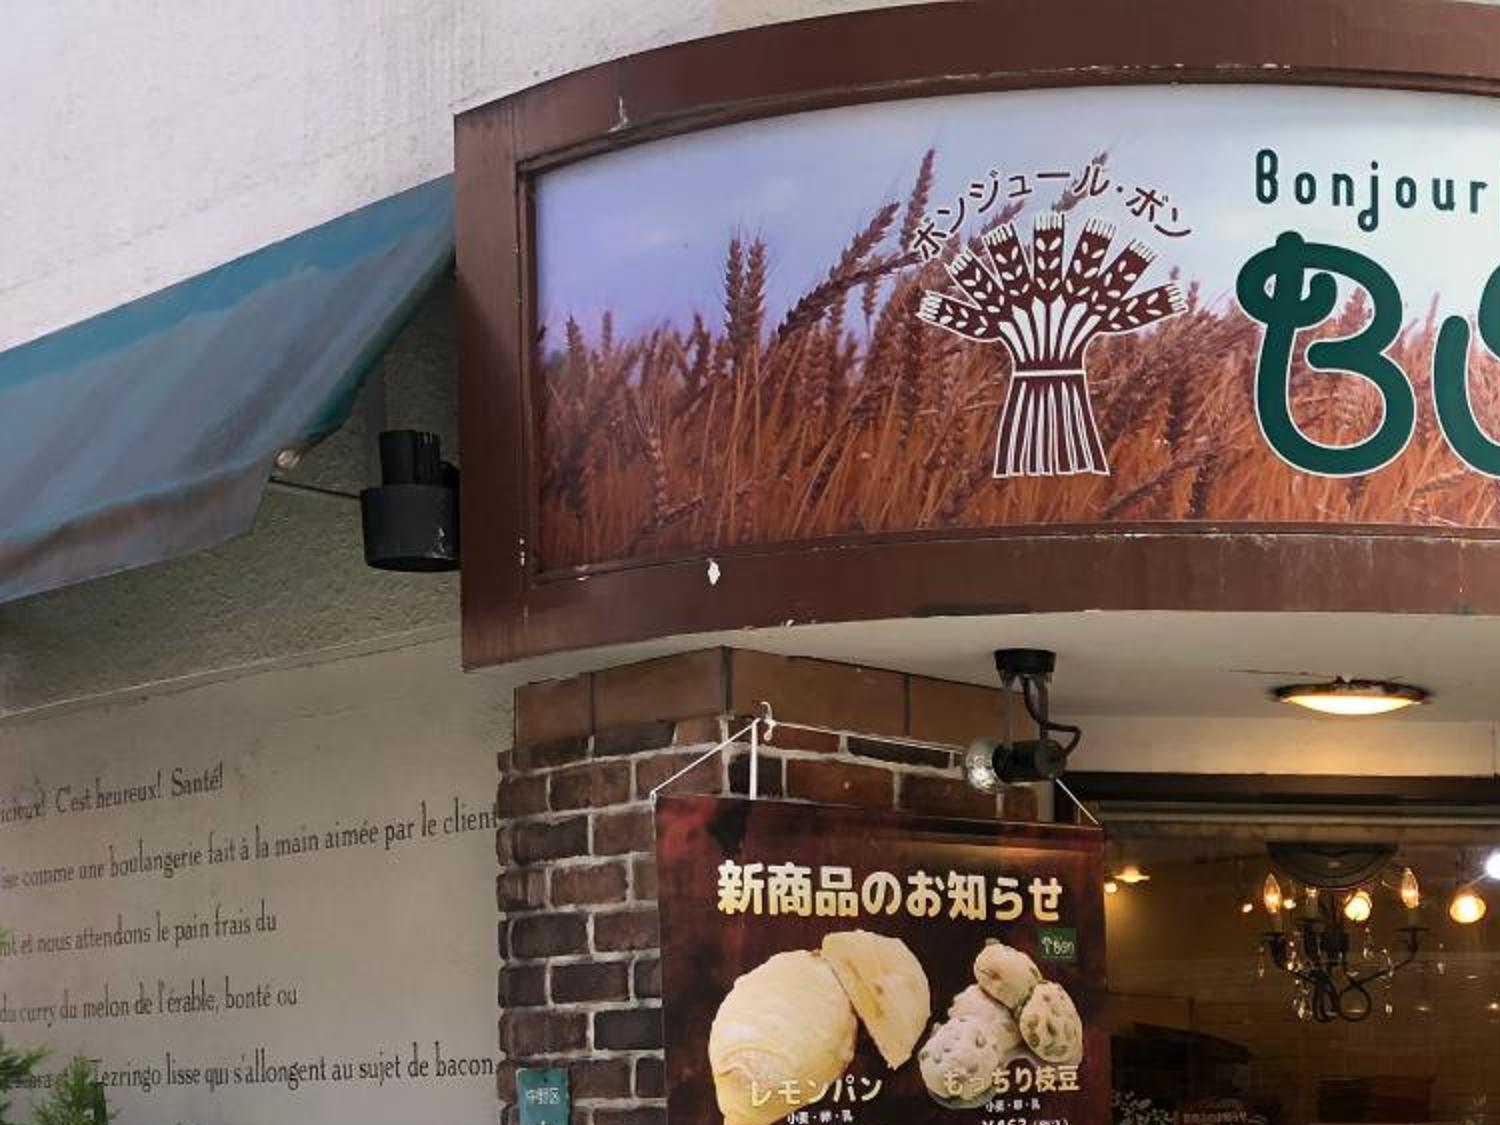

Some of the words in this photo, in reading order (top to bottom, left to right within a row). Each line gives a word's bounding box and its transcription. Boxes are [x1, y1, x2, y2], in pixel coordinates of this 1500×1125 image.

[911, 158, 1194, 264] ボンジュール・ボン
[1254, 148, 1489, 232] Bonjour
[95, 769, 162, 809] heureux!
[171, 759, 224, 797] Santé!
[109, 836, 203, 878] boulangerie
[208, 831, 236, 865] fait
[255, 823, 269, 859] la
[275, 825, 319, 857] main
[325, 820, 379, 849] aimée
[384, 822, 415, 850] par
[420, 800, 437, 837] le
[716, 859, 1064, 923] 新商品のお知らせ
[75, 912, 151, 950] attendons
[156, 910, 169, 943] le
[175, 912, 209, 948] pain
[215, 902, 251, 938] frais
[255, 898, 277, 932] du
[83, 982, 129, 1019] melon
[135, 980, 153, 1015] de
[225, 976, 272, 1010] bonté
[277, 986, 298, 1007] ou
[165, 1051, 200, 1086] lisse
[204, 1063, 230, 1093] qui
[332, 1062, 353, 1081] au
[359, 1048, 402, 1087] sujet
[408, 1041, 430, 1078] de
[746, 1075, 884, 1107] レモンパン
[943, 1065, 1080, 1096] もっちり枝豆
[527, 1088, 560, 1105] 中野区
